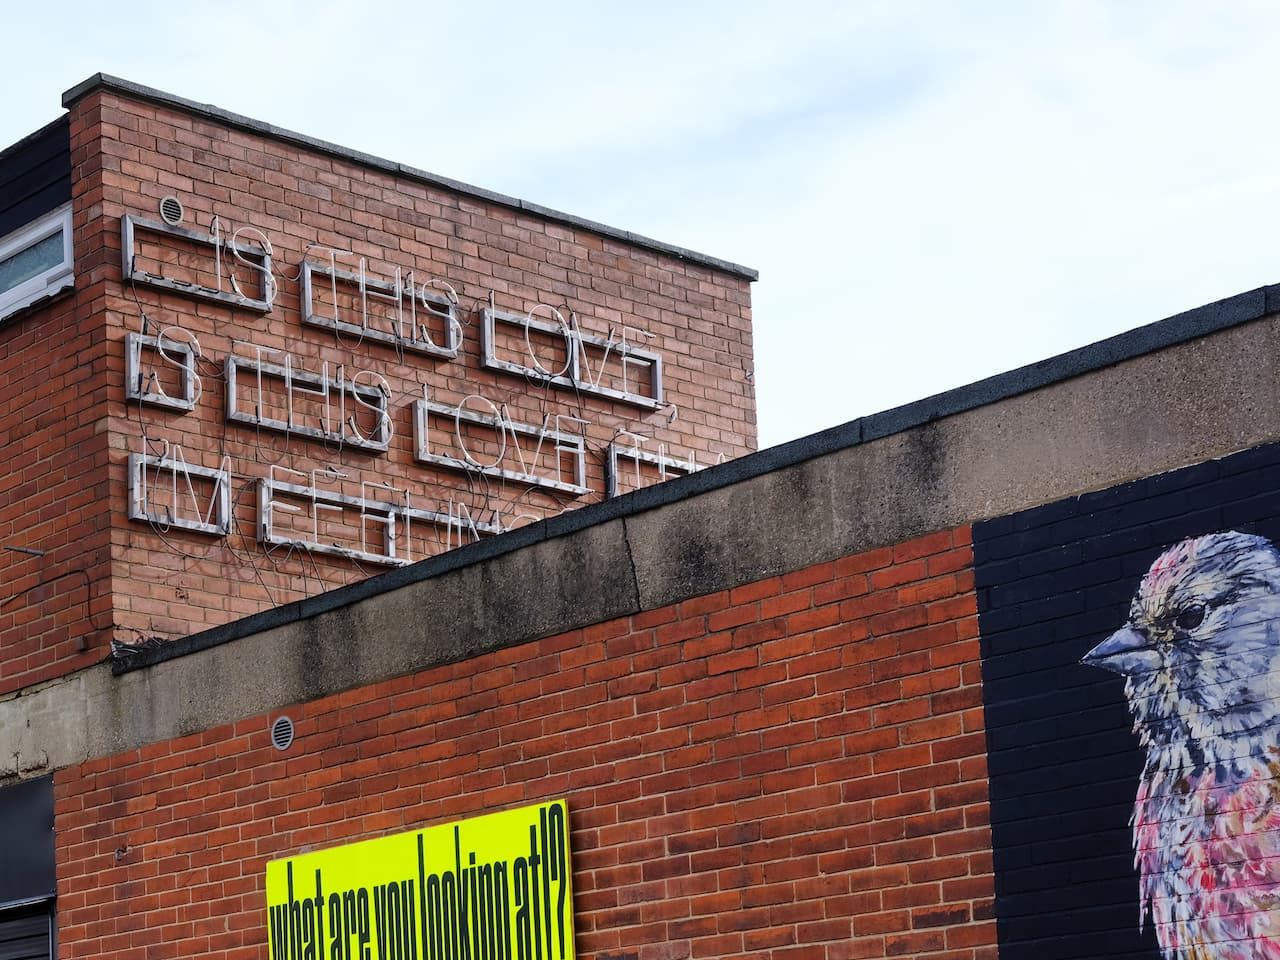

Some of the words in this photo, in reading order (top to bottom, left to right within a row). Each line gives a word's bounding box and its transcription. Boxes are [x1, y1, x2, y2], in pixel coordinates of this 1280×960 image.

[304, 244, 464, 354] THIS
[138, 315, 203, 406] IS
[232, 341, 394, 448] THIS
[423, 382, 592, 489] LOVE
